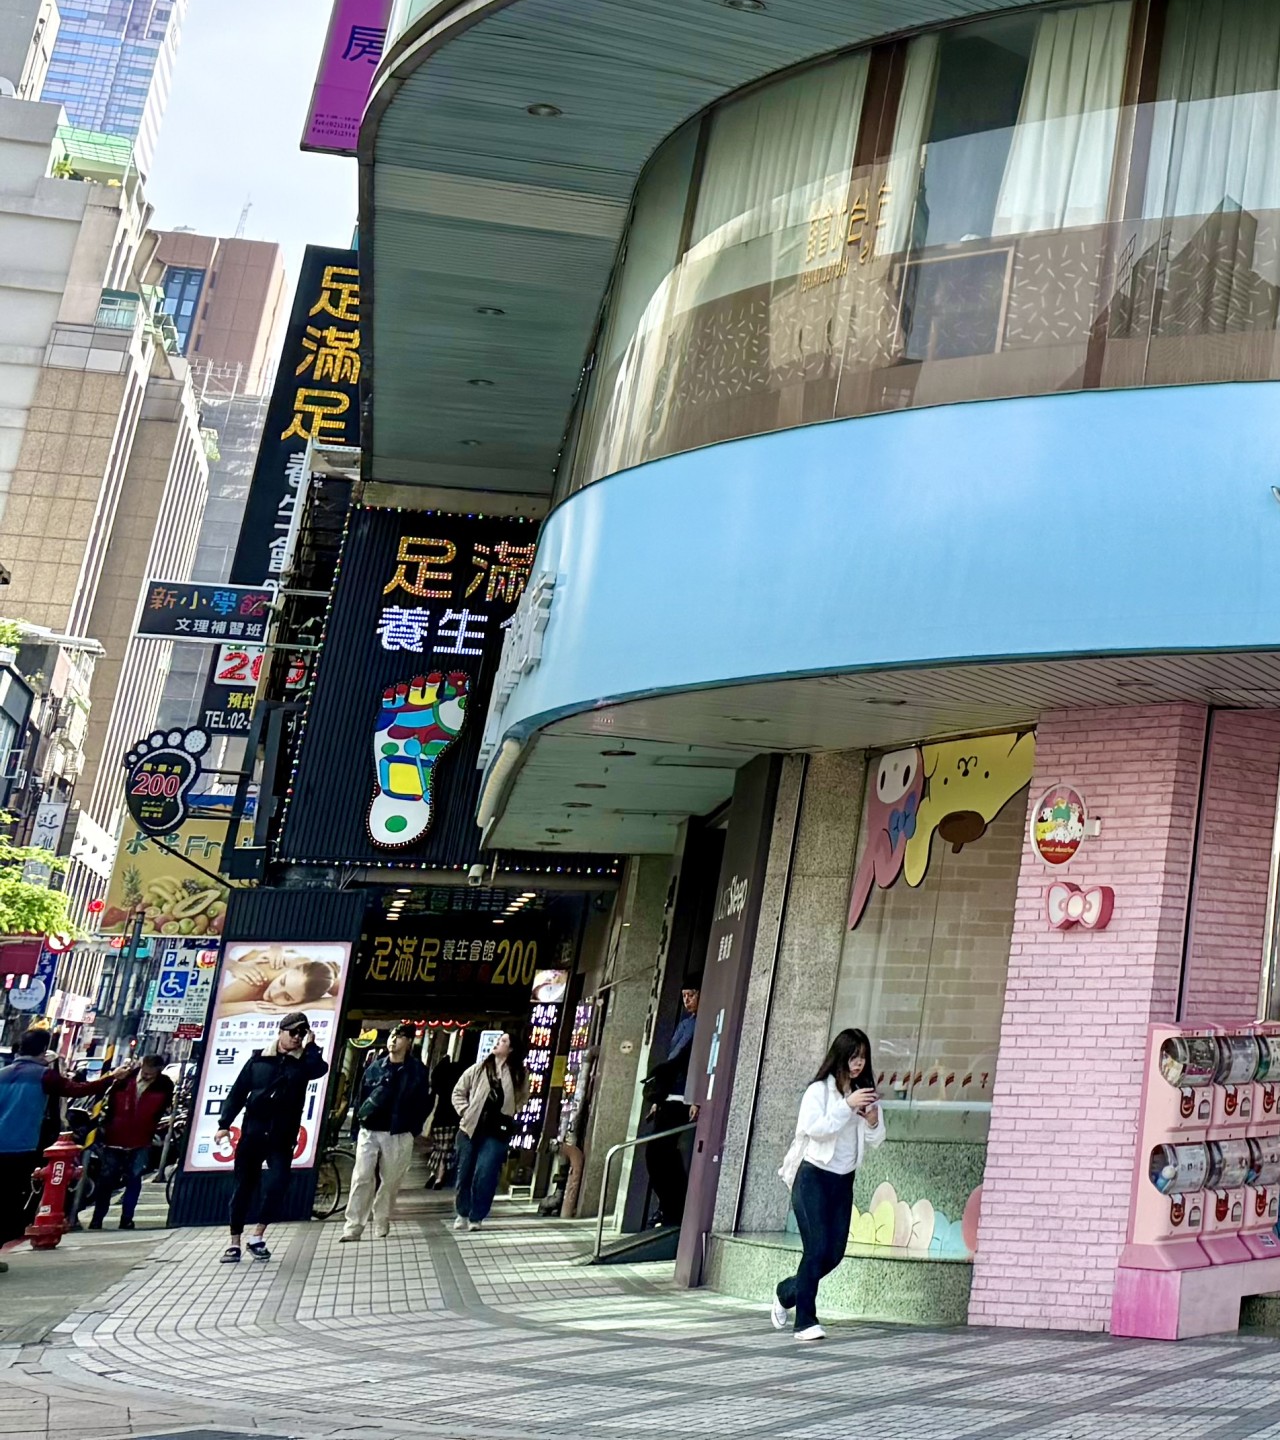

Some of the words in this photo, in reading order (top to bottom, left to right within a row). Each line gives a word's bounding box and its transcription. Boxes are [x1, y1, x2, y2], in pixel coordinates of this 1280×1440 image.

[281, 265, 361, 444] 足滿足
[174, 617, 263, 638] 文理補習班
[376, 604, 517, 656] 養生
[131, 772, 181, 798] 200
[365, 935, 441, 983] 足滿足
[491, 938, 538, 986] 200
